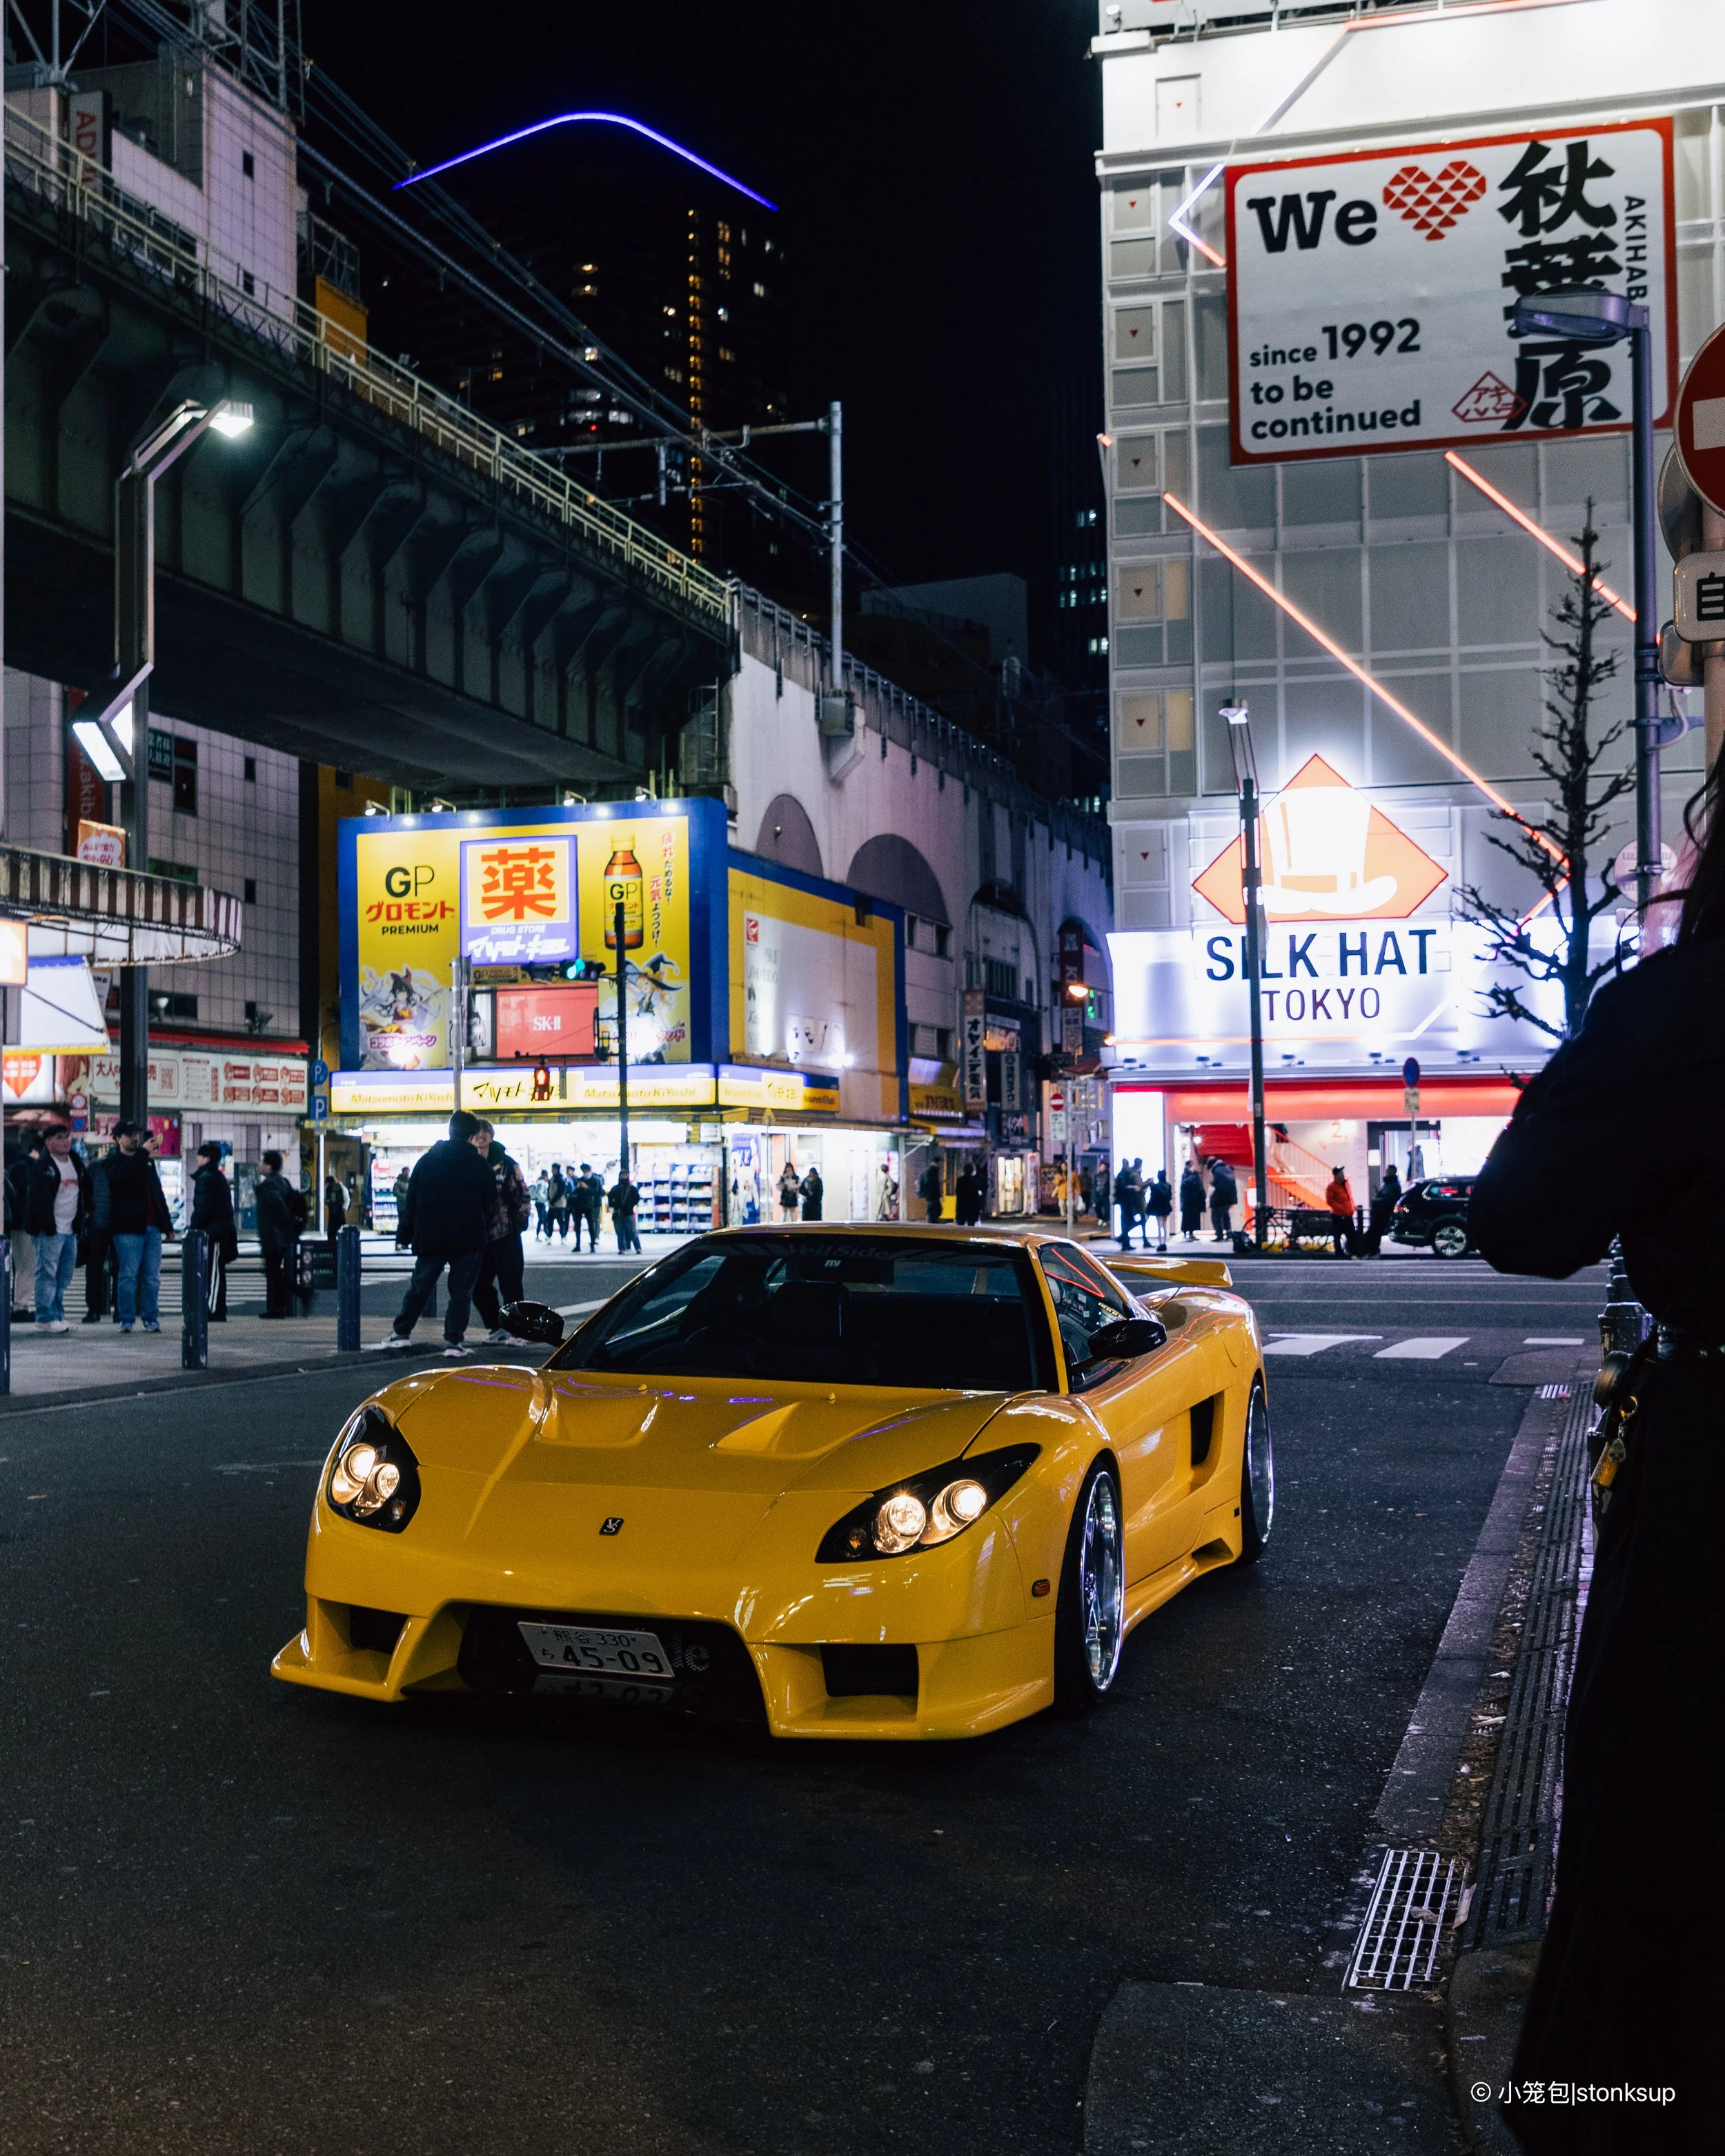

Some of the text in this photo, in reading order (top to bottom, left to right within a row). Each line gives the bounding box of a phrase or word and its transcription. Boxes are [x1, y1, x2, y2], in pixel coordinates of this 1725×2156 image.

[1246, 189, 1377, 254] We
[1497, 139, 1624, 431] 秋葉原
[1250, 317, 1421, 367] since 1992
[1250, 375, 1334, 405] to be
[1250, 399, 1421, 440] continued
[385, 865, 435, 898] GP
[481, 847, 557, 920] 薬
[610, 882, 638, 900] GP
[366, 900, 455, 922] グロモント
[382, 924, 439, 936] PREMIUM
[491, 924, 546, 936] DRUG STORE
[468, 934, 570, 962] マツモトキヨシ
[1339, 929, 1437, 976] HAT
[1261, 987, 1380, 1021] TOKYO
[315, 1098, 325, 1119] P
[351, 1093, 414, 1104] Matsumoto
[553, 1629, 631, 1648] 熊谷 330
[562, 1645, 664, 1674] 45-09
